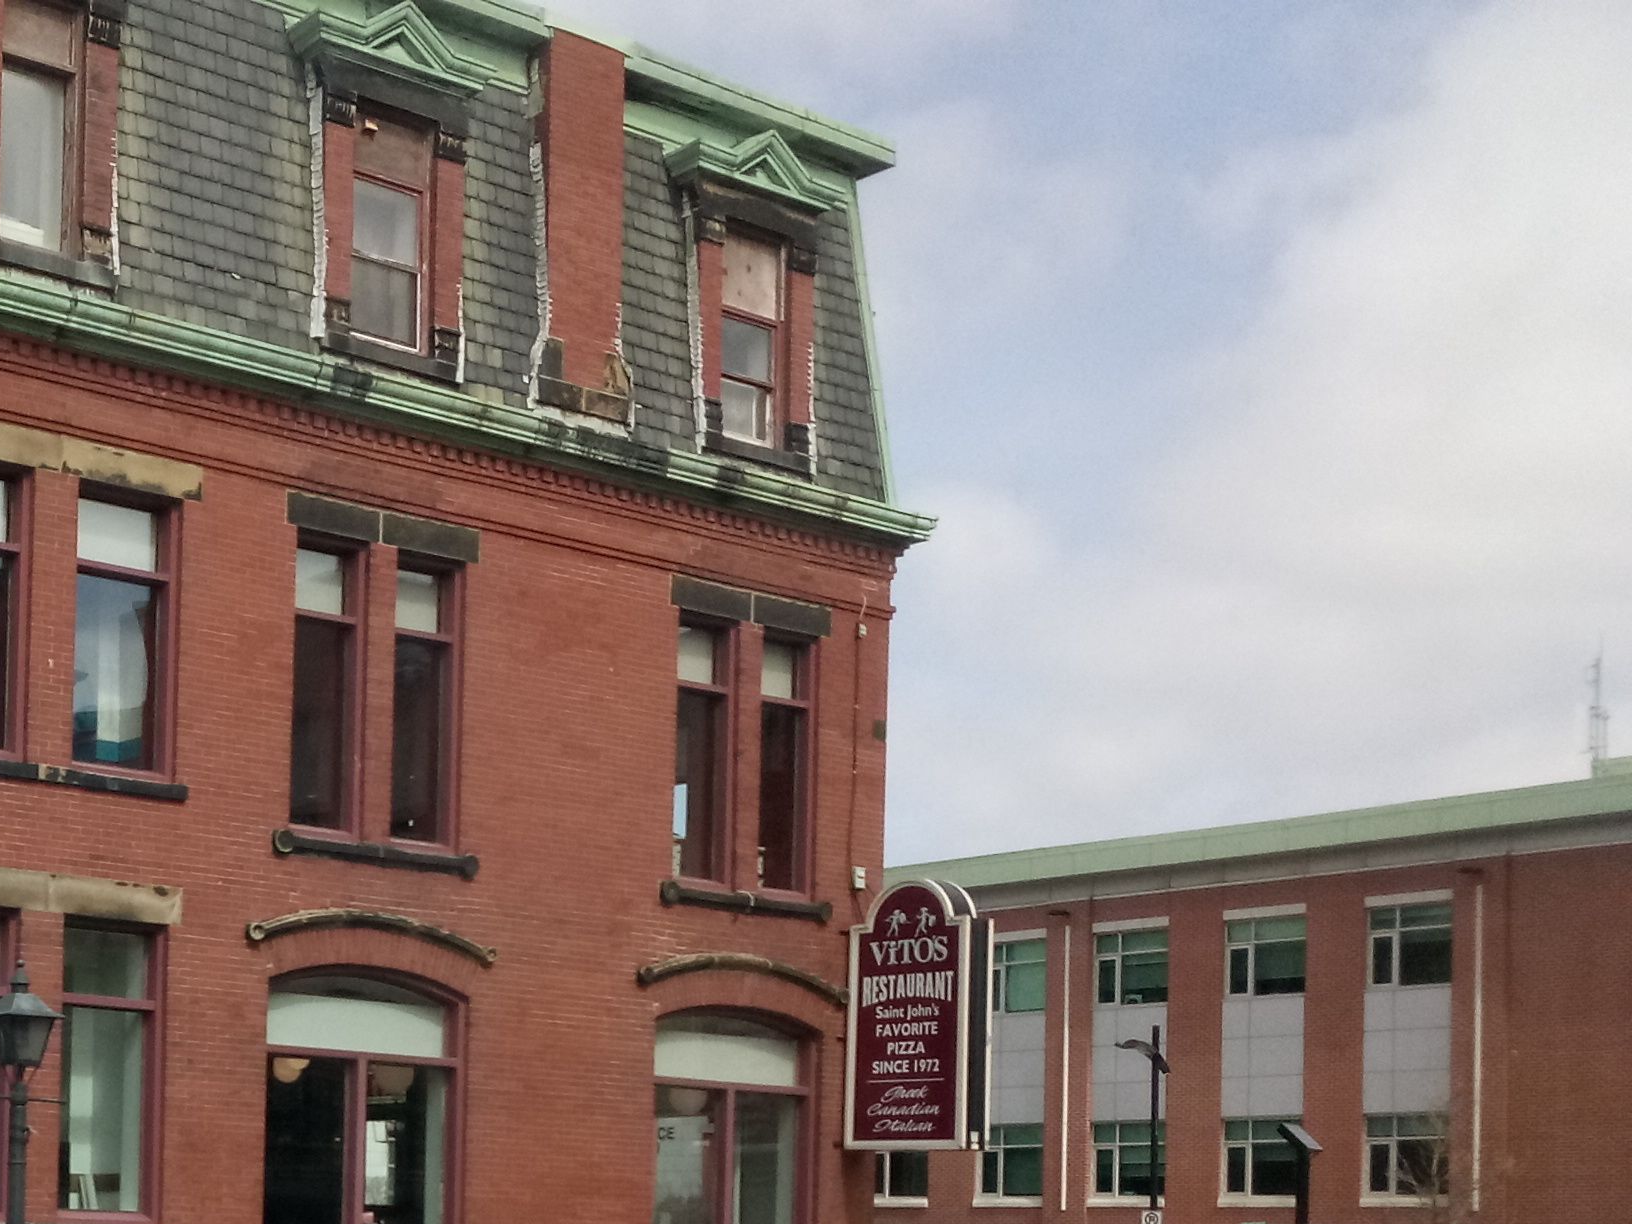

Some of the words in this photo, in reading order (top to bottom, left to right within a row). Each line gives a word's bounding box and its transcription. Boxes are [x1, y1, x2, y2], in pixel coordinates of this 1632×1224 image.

[862, 970, 954, 1007] RESTAURANT
[875, 1005, 905, 1019] Saint
[907, 1003, 940, 1020] John's
[876, 1021, 939, 1037] FAVORITE
[887, 1041, 925, 1055] PIZZA
[872, 1060, 910, 1074] SINCE
[914, 1059, 940, 1072] 1972
[880, 1085, 929, 1103] Greek
[866, 1102, 940, 1116] Canadian
[872, 1119, 936, 1133] Italian
